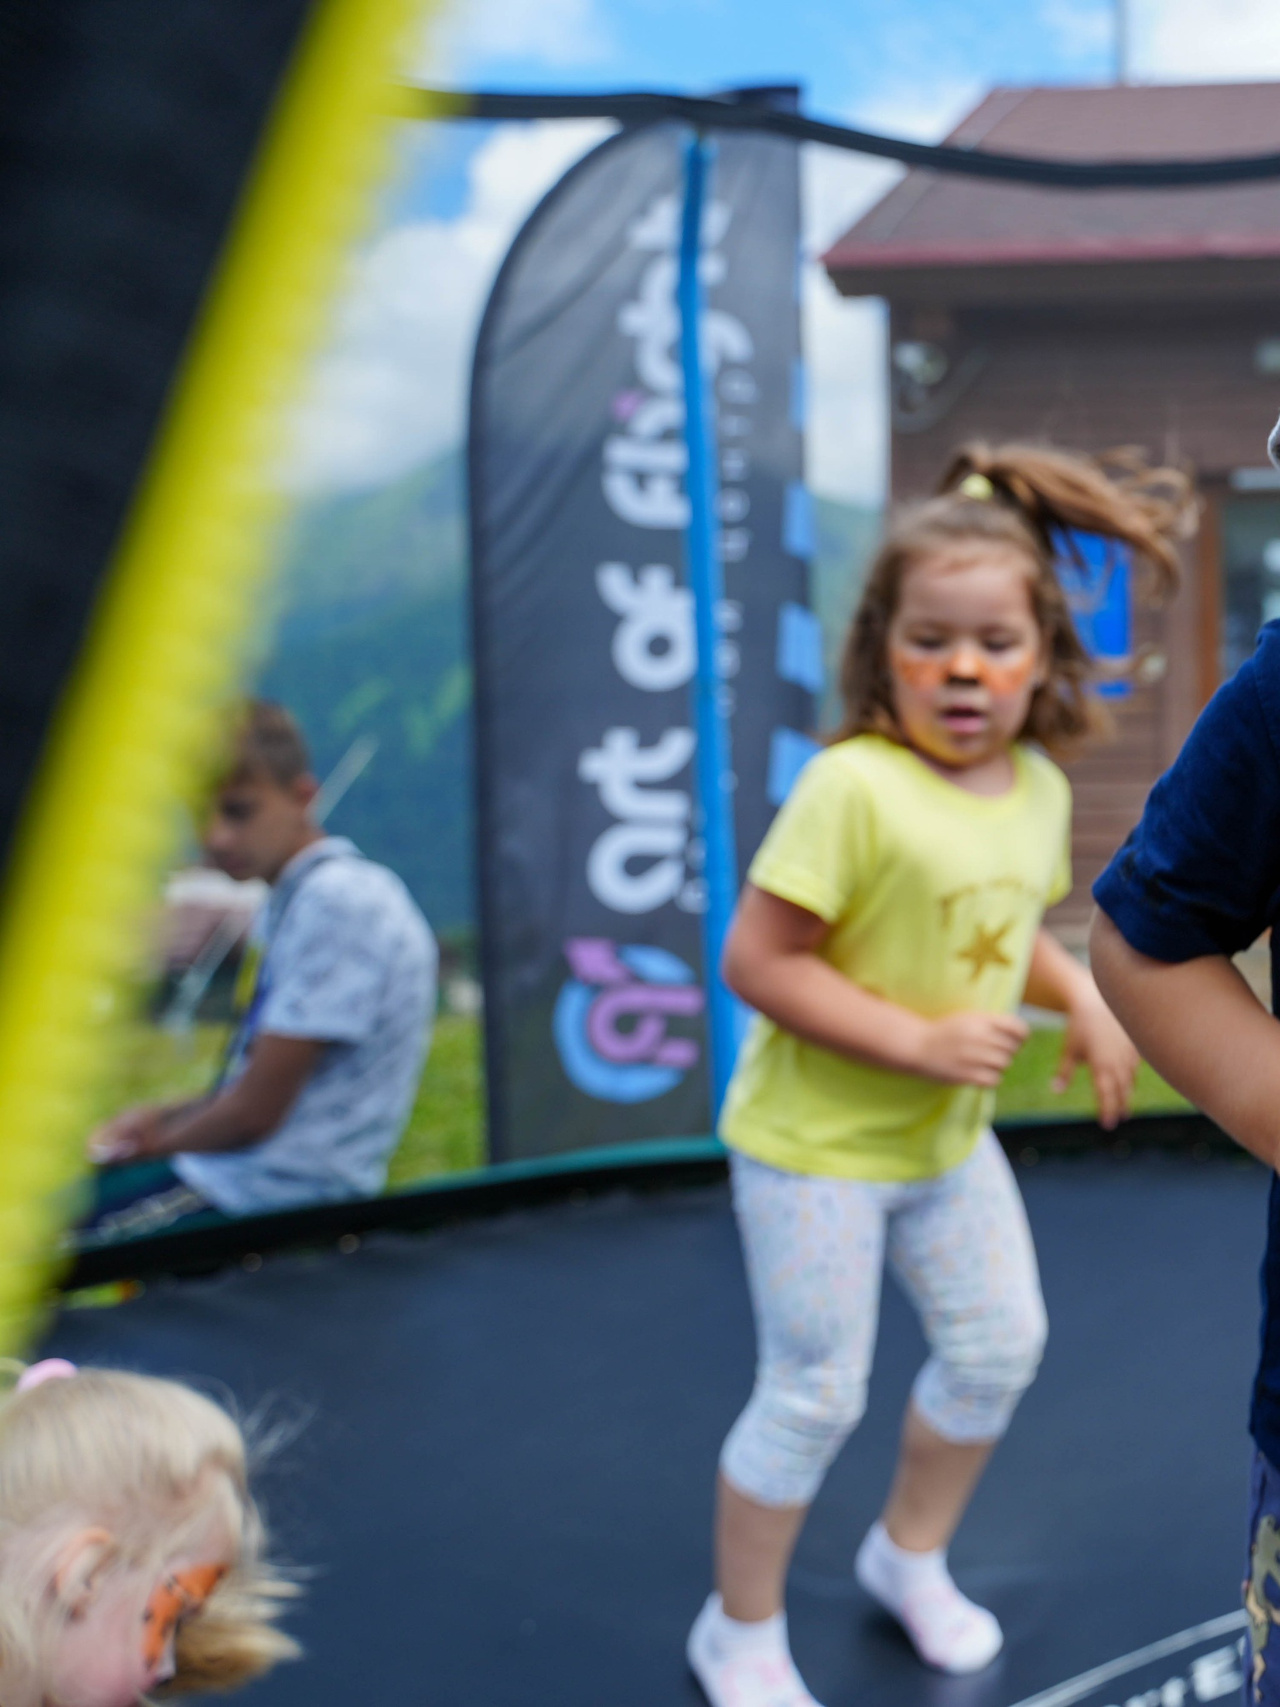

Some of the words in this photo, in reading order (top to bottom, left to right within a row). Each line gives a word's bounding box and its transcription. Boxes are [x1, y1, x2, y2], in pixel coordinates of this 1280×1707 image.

[602, 196, 755, 530] flight
[596, 560, 699, 693] of
[577, 726, 698, 915] art
